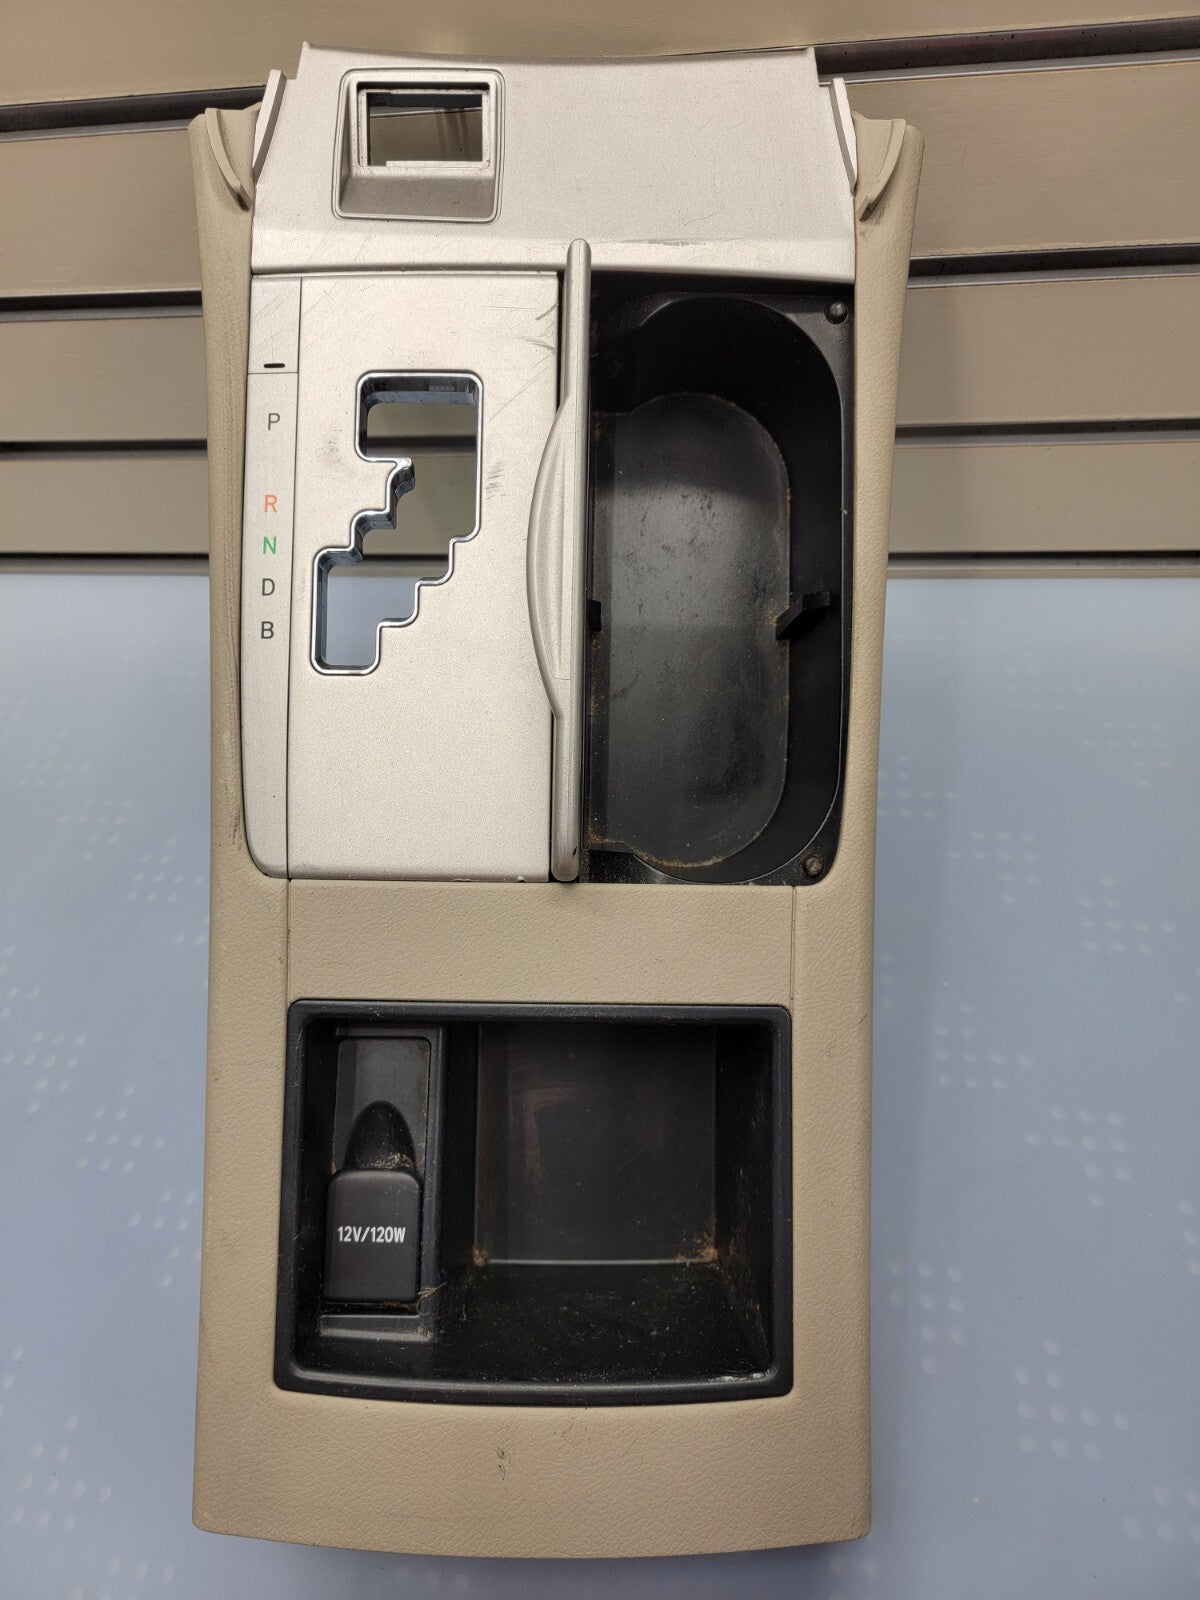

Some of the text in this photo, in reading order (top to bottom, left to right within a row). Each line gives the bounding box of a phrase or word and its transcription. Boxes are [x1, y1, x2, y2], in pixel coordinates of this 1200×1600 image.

[267, 412, 281, 431] P
[264, 494, 278, 513] R
[262, 536, 277, 555] N
[261, 577, 276, 597] D
[260, 621, 275, 640] B
[337, 1225, 407, 1243] 12V/120W
